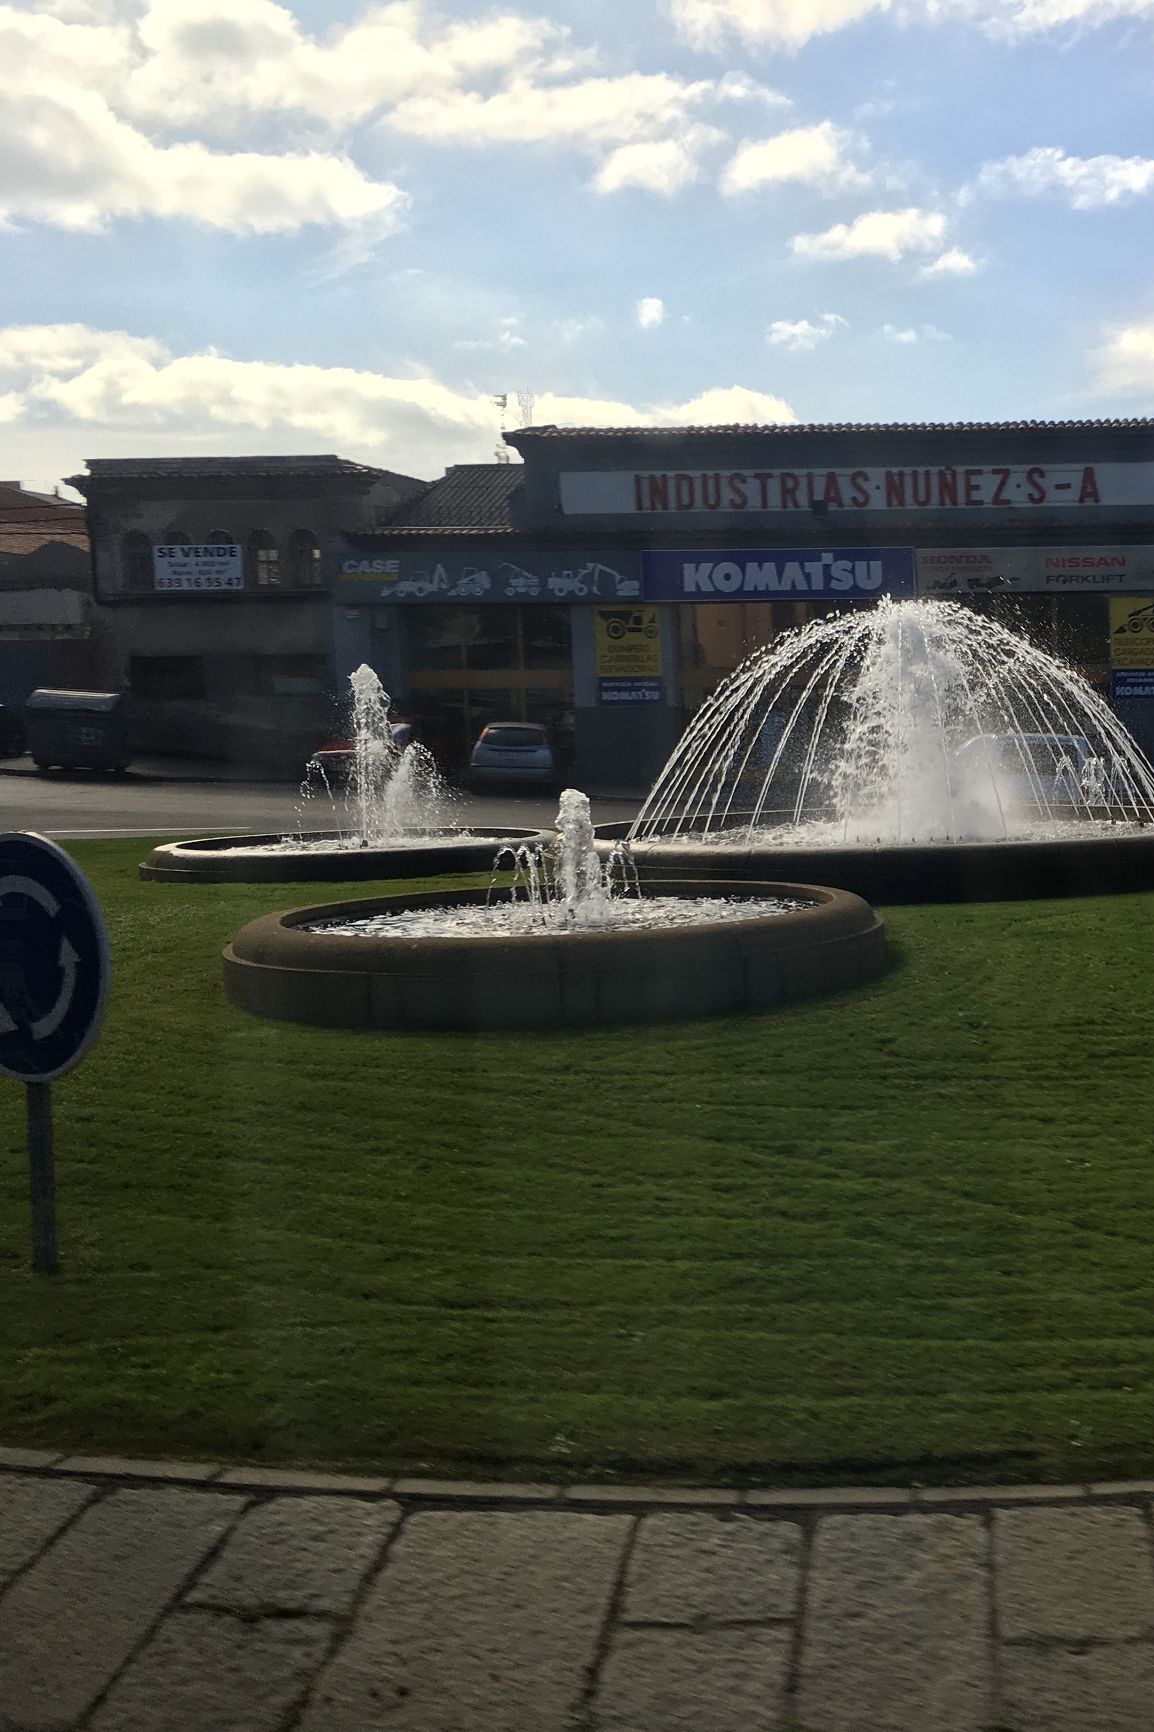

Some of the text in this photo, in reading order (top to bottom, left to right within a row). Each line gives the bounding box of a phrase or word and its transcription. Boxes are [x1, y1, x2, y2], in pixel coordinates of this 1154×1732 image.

[634, 470, 870, 511] INDUSTRIAS
[157, 546, 238, 558] SE VENDE
[921, 554, 993, 565] HONDA
[1045, 557, 1126, 568] NISSAN
[342, 560, 400, 573] CASE
[683, 552, 883, 592] KOMATSU
[1046, 574, 1127, 585] FORKLIFT
[601, 688, 660, 701] KOMATSU
